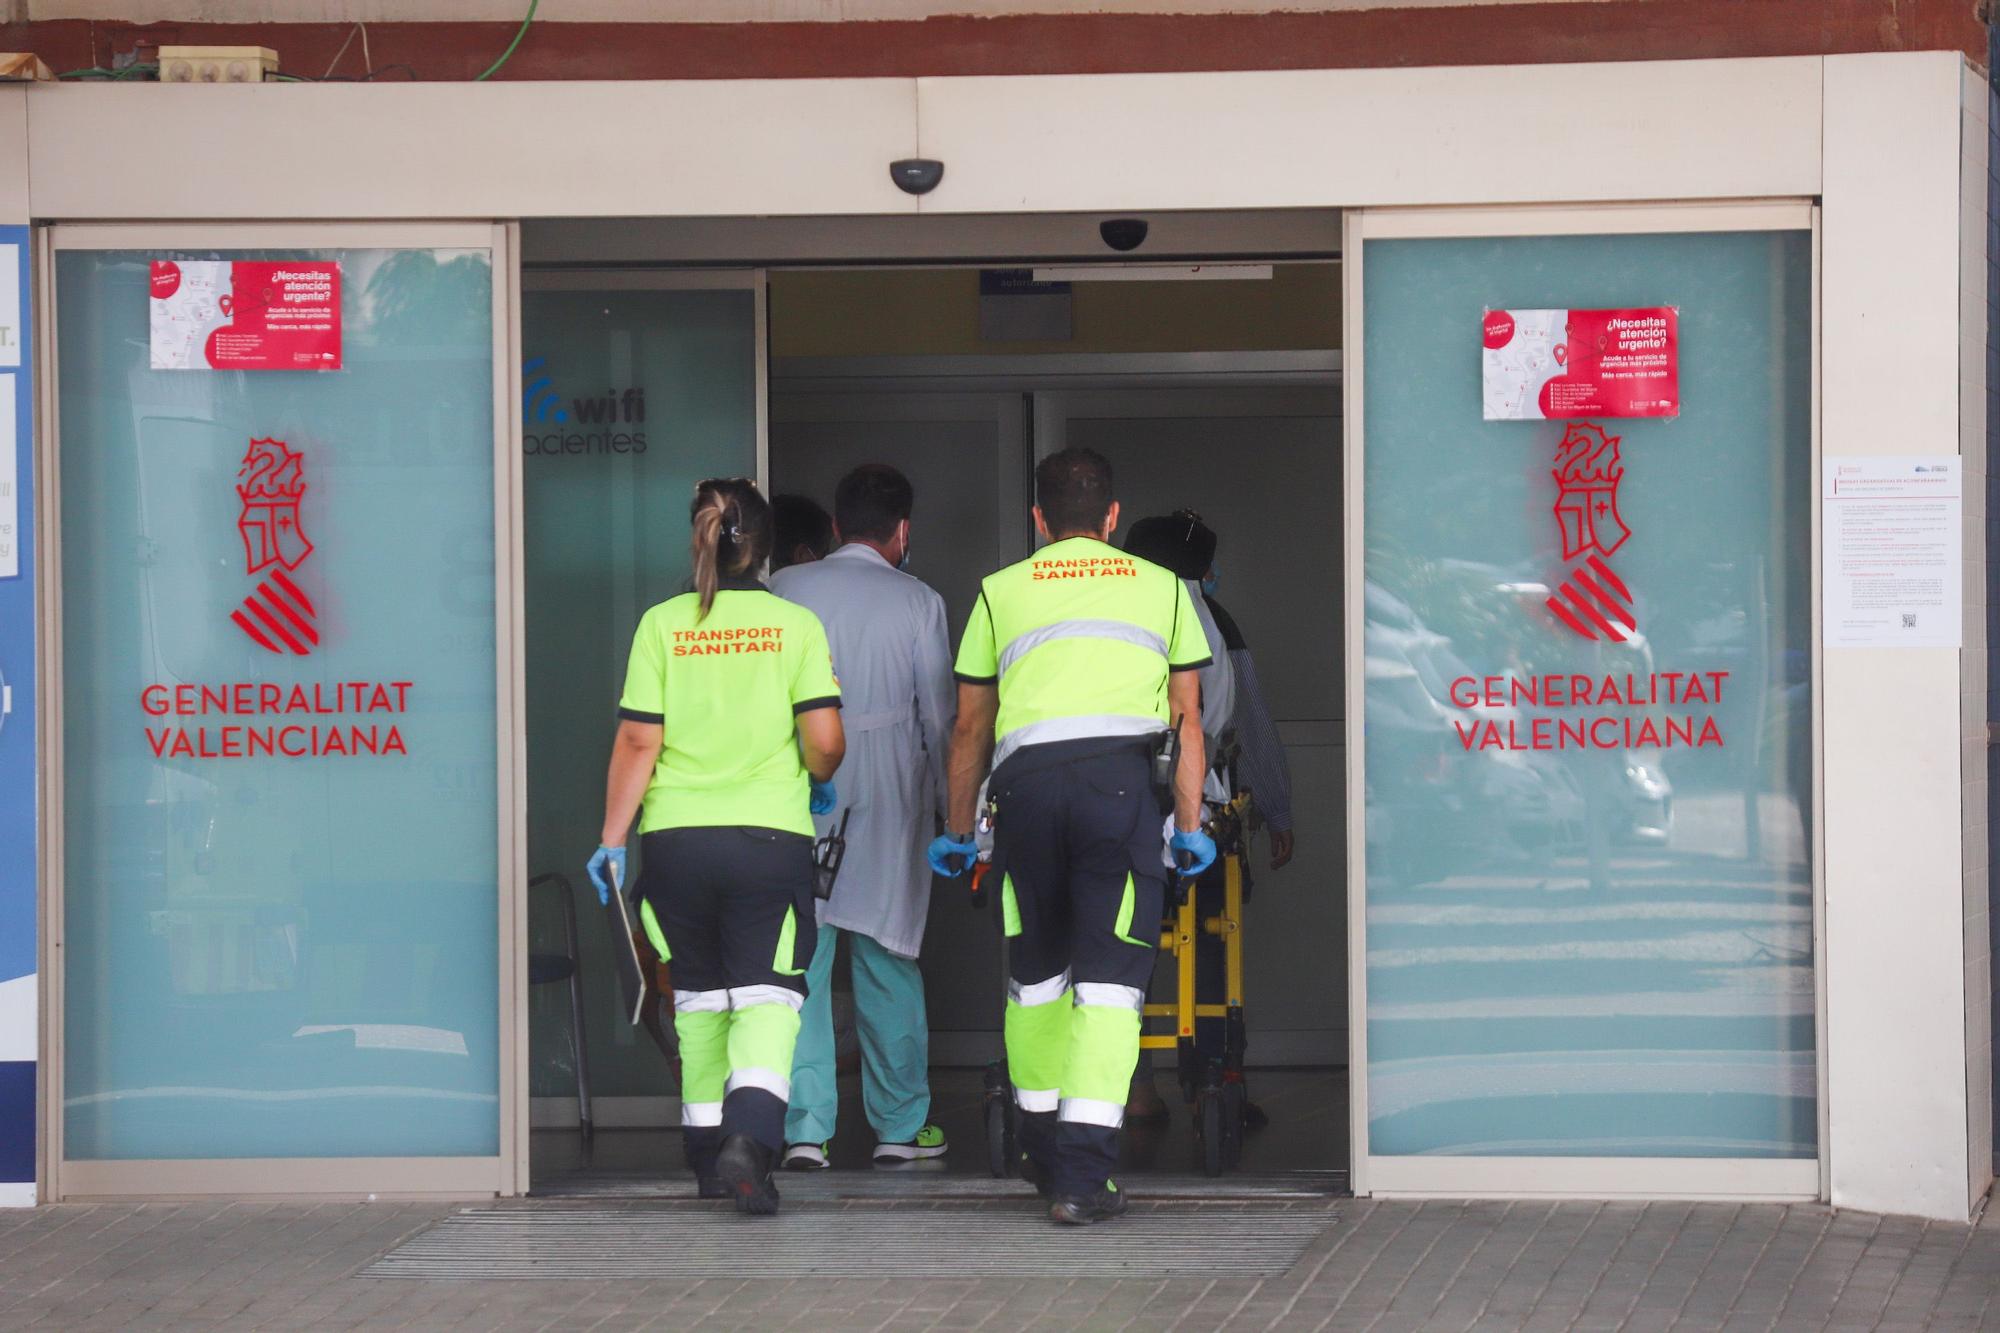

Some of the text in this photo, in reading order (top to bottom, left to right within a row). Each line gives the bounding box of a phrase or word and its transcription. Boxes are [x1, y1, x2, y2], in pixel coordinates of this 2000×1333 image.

[271, 270, 331, 282] ¿Necesitas
[284, 280, 331, 291] atención
[283, 291, 331, 303] urgente?
[1607, 318, 1666, 332] ¿Necesitas
[1620, 328, 1666, 339] atención
[1619, 338, 1666, 351] urgente?
[573, 388, 646, 424] wifi
[523, 427, 647, 455] acientes
[1032, 558, 1135, 570] TRANSPORT
[1032, 567, 1137, 580] SANITARI
[673, 627, 783, 642] TRANSPORT
[673, 641, 783, 657] SANITARI
[1449, 672, 1729, 709] GENERALITAT
[140, 682, 413, 716] GENERALITAT
[1454, 715, 1724, 751] VALENCIANA
[144, 725, 407, 758] VALENCIANA
